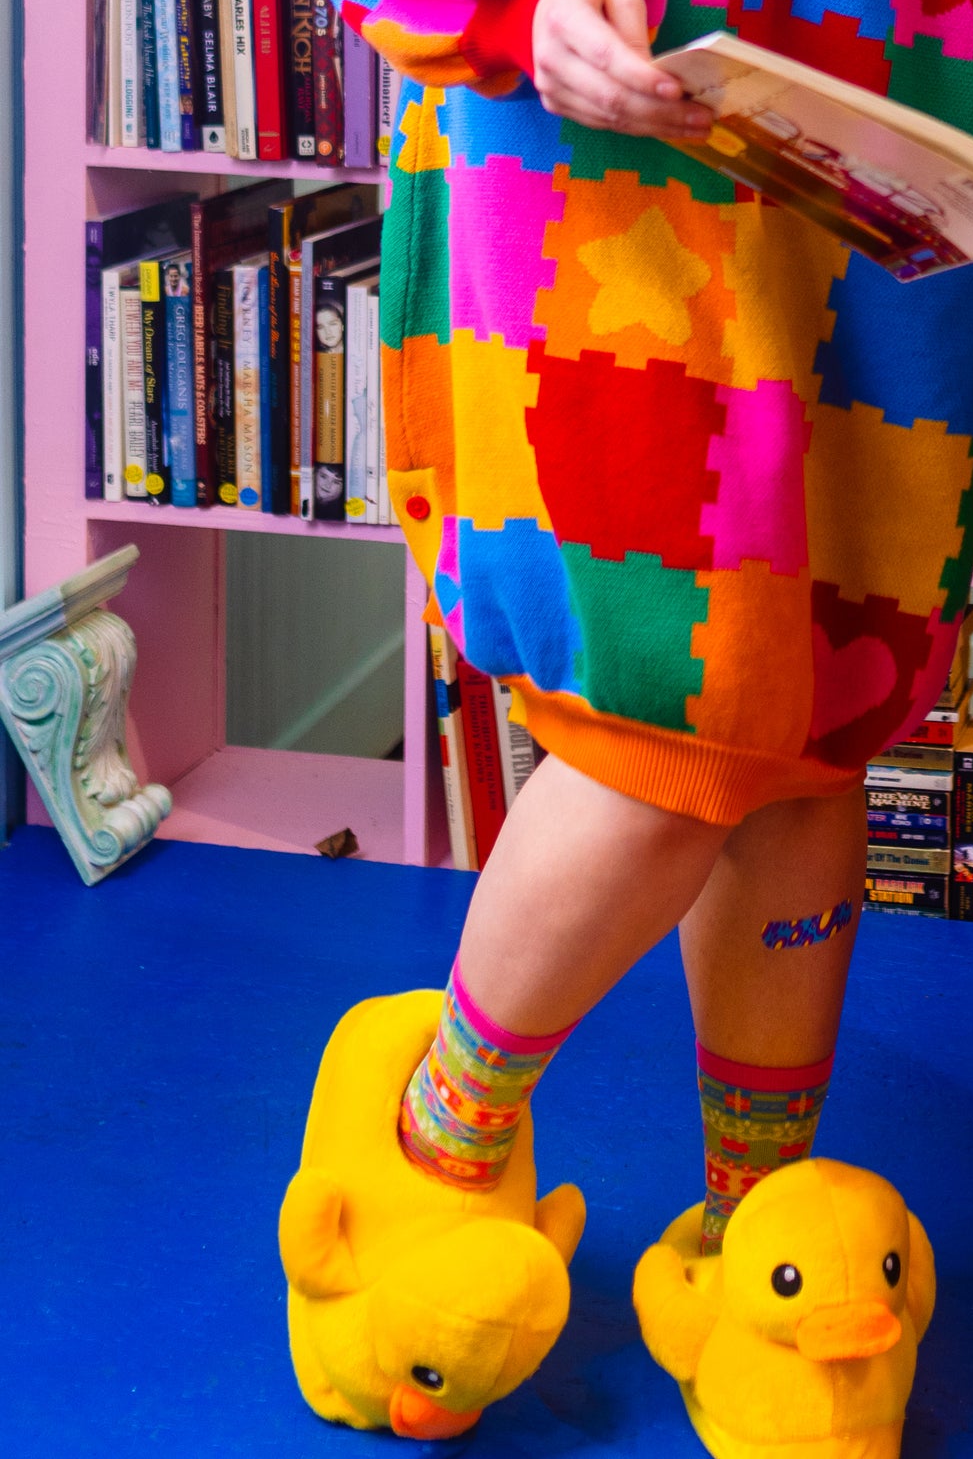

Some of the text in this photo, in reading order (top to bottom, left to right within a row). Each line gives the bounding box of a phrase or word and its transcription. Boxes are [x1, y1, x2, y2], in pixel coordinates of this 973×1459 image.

[124, 21, 133, 46] POST
[314, 6, 328, 37] 70s
[143, 41, 154, 66] About
[235, 35, 246, 56] HIX
[291, 10, 315, 77] RICH
[203, 30, 217, 113] SELMA BLAIR
[124, 78, 133, 119] BLOGGING
[193, 213, 202, 229] The
[193, 229, 203, 275] International
[194, 275, 203, 293] Book
[194, 294, 203, 304] of
[107, 284, 115, 342] TWYLA THARP
[194, 304, 204, 328] BEER
[216, 283, 231, 337] Finding
[240, 279, 252, 344] JOURNEY
[124, 297, 142, 392] BETWEEN YOU AND ME
[143, 308, 155, 404] My Dream of Stars
[174, 305, 187, 409] GREG LOUGANIS
[195, 364, 205, 390] MATS
[330, 391, 336, 403] MY
[127, 400, 144, 459] PEARL BAILEY
[195, 398, 206, 445] COASTERS
[242, 359, 254, 474] MARSHA MASON
[869, 792, 930, 801] THE WAR
[869, 798, 931, 810] MACHINE
